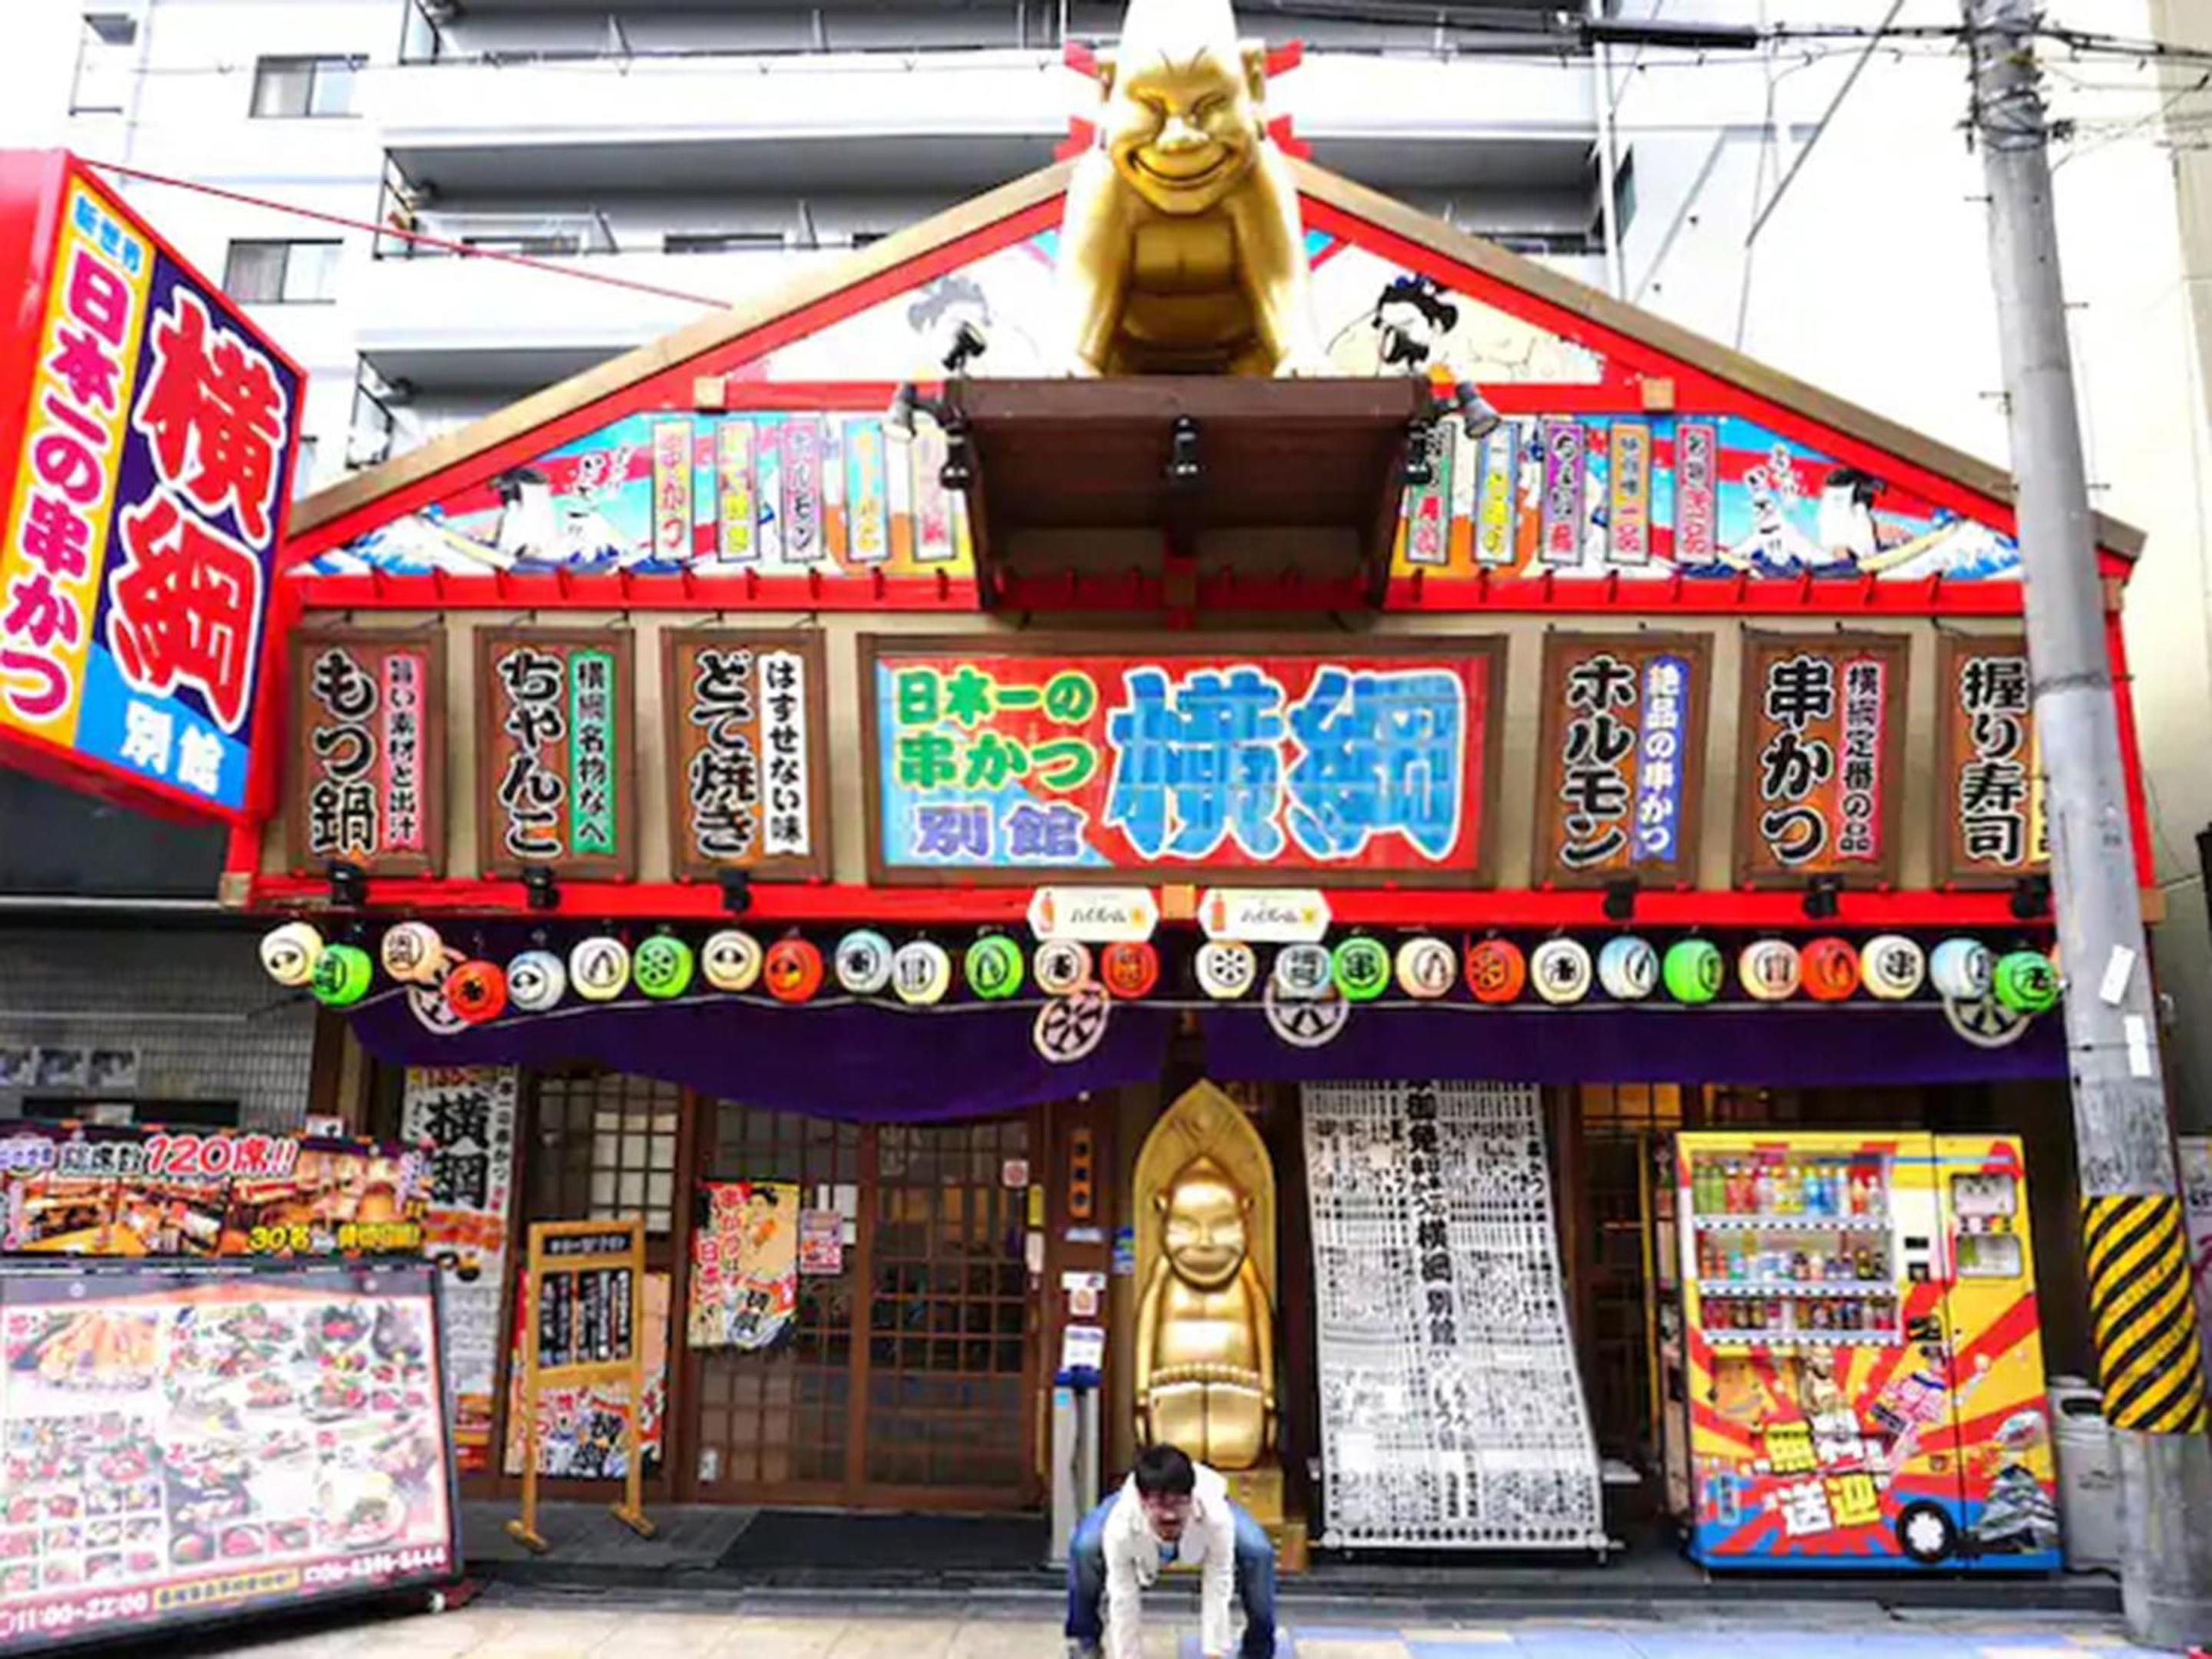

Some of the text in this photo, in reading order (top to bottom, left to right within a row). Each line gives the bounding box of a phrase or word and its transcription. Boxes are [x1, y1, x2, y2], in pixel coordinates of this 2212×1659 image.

[75, 195, 142, 274] 新世界
[2, 250, 133, 723] 日本一の串かつ
[107, 286, 286, 733] 横綱
[123, 699, 227, 796] 別館
[311, 647, 379, 855] もつ鍋
[499, 647, 563, 859] ちゃんこ
[691, 649, 759, 856] どて焼き
[896, 667, 1096, 726] 日本一の
[899, 732, 1097, 792] 串かつ
[1103, 666, 1465, 861] 横綱
[1560, 654, 1637, 866] ホルモン
[1761, 656, 1833, 865] 串かつ
[1960, 657, 2029, 863] 握り寿司
[916, 804, 1085, 858] 別館
[425, 1092, 492, 1210] 横綱
